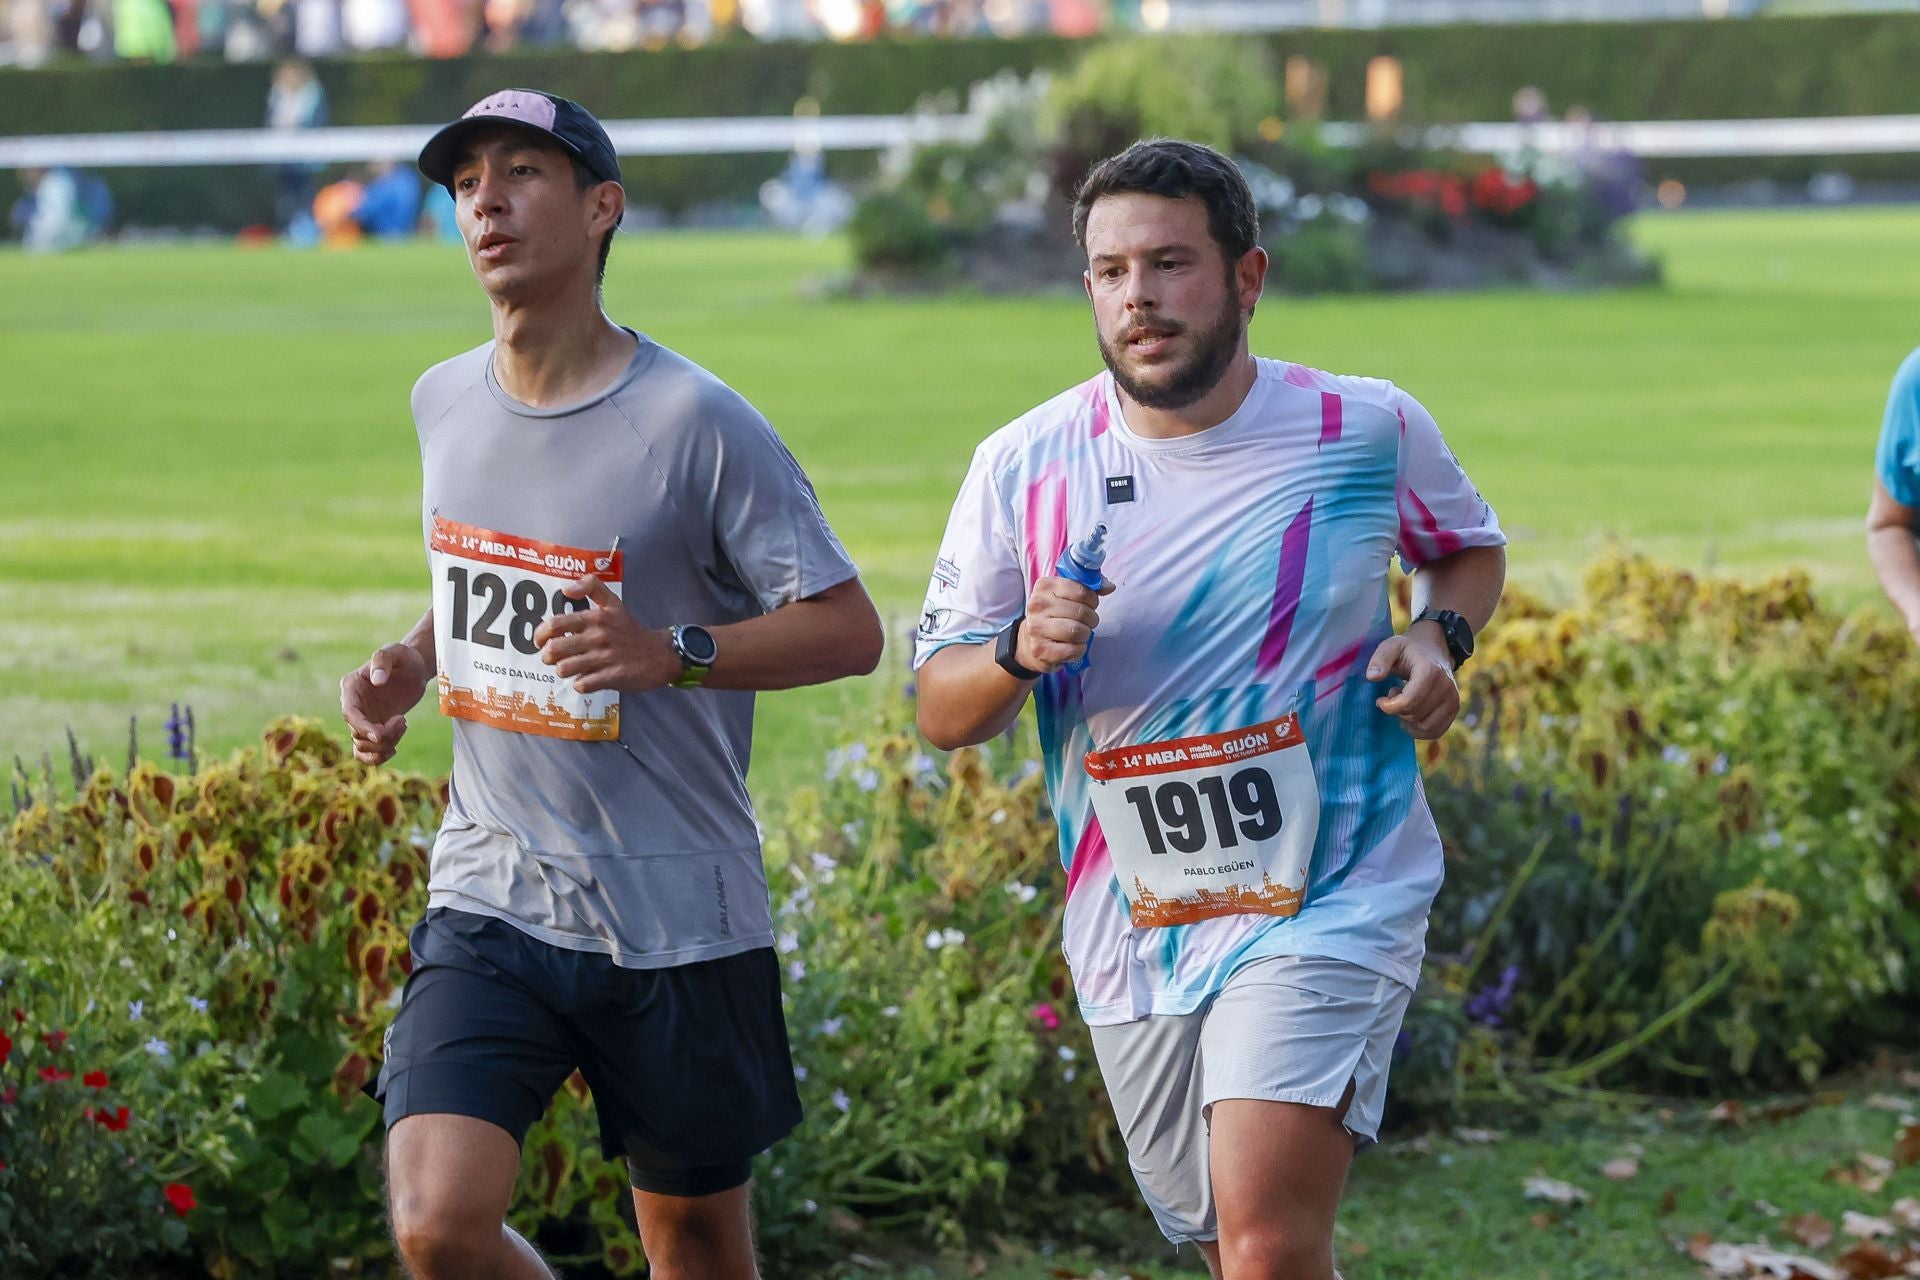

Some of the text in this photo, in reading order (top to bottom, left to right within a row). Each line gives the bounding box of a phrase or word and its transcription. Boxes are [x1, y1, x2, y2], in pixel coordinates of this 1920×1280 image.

[479, 540, 518, 559] MBA
[544, 554, 586, 572] GIJÓN
[473, 661, 555, 683] CARLOS DAVALOS
[1145, 748, 1189, 767] MBA
[1222, 732, 1269, 755] GIJÓN
[1189, 743, 1212, 753] media
[1191, 749, 1223, 760] maratón
[1125, 767, 1283, 854] 1919
[1184, 860, 1255, 876] PABLO EGÜEN
